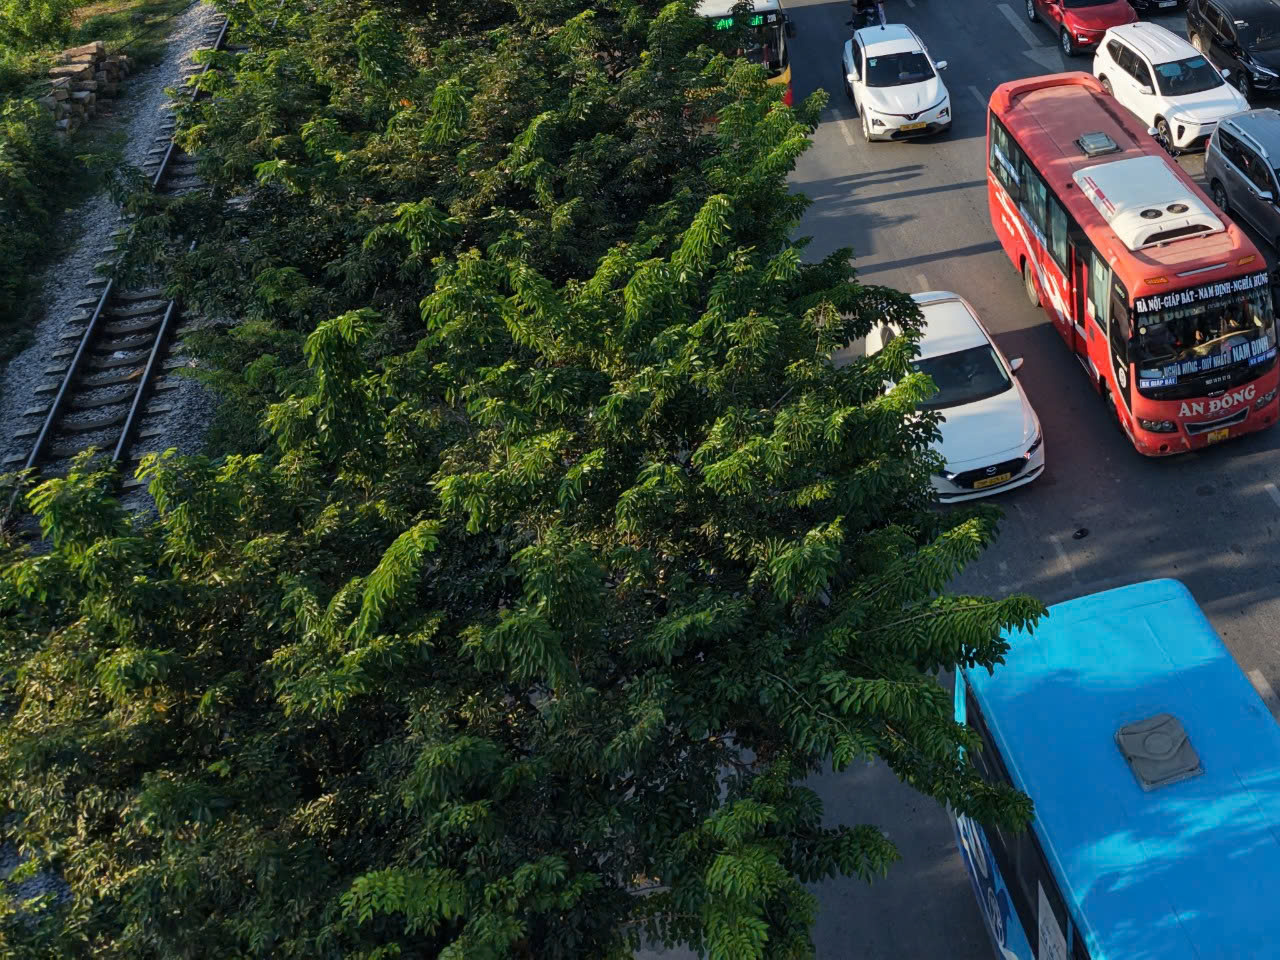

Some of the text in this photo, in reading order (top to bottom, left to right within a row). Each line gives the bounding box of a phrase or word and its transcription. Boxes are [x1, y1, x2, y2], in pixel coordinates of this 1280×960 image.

[1136, 298, 1148, 313] HÀ
[1180, 289, 1195, 305] BÁT
[1199, 285, 1214, 300] NAM
[1163, 362, 1181, 377] NGHĨA
[1232, 343, 1251, 362] NAM
[1178, 401, 1205, 417] AN
[1209, 384, 1257, 412] ĐÔNG
